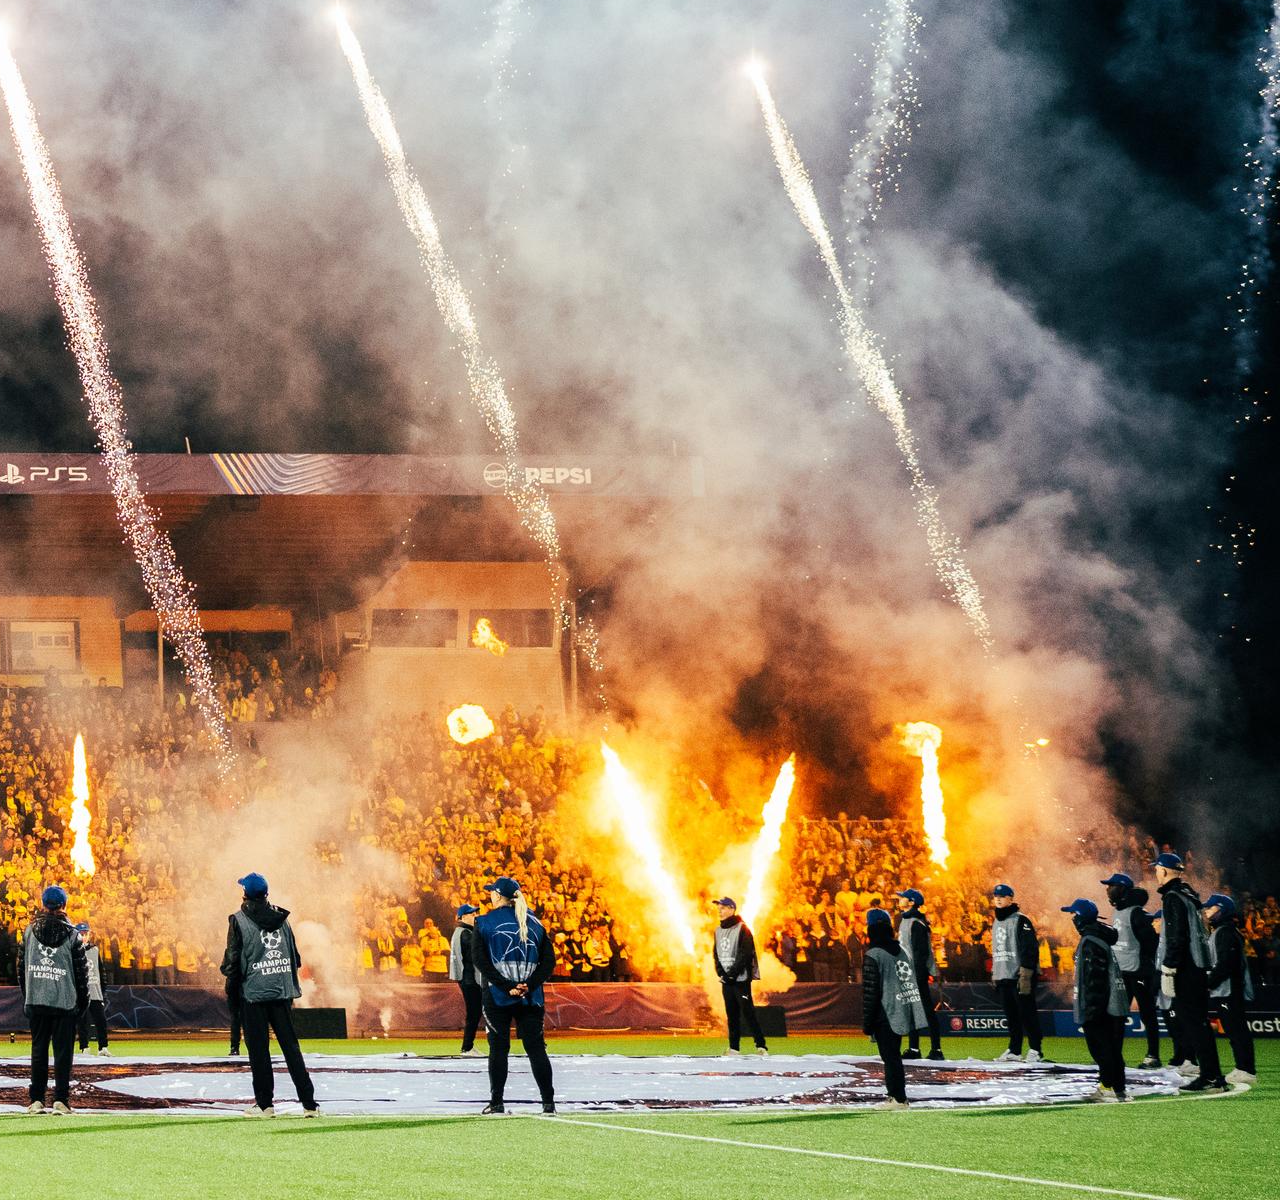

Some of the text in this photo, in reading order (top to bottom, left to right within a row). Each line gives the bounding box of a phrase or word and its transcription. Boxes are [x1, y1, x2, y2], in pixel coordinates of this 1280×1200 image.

[30, 466, 88, 481] PS5
[525, 467, 591, 484] PEPSI
[252, 958, 291, 970] CHAMPIO
[261, 965, 291, 976] LEAGUE
[966, 1018, 1009, 1029] RESPEC
